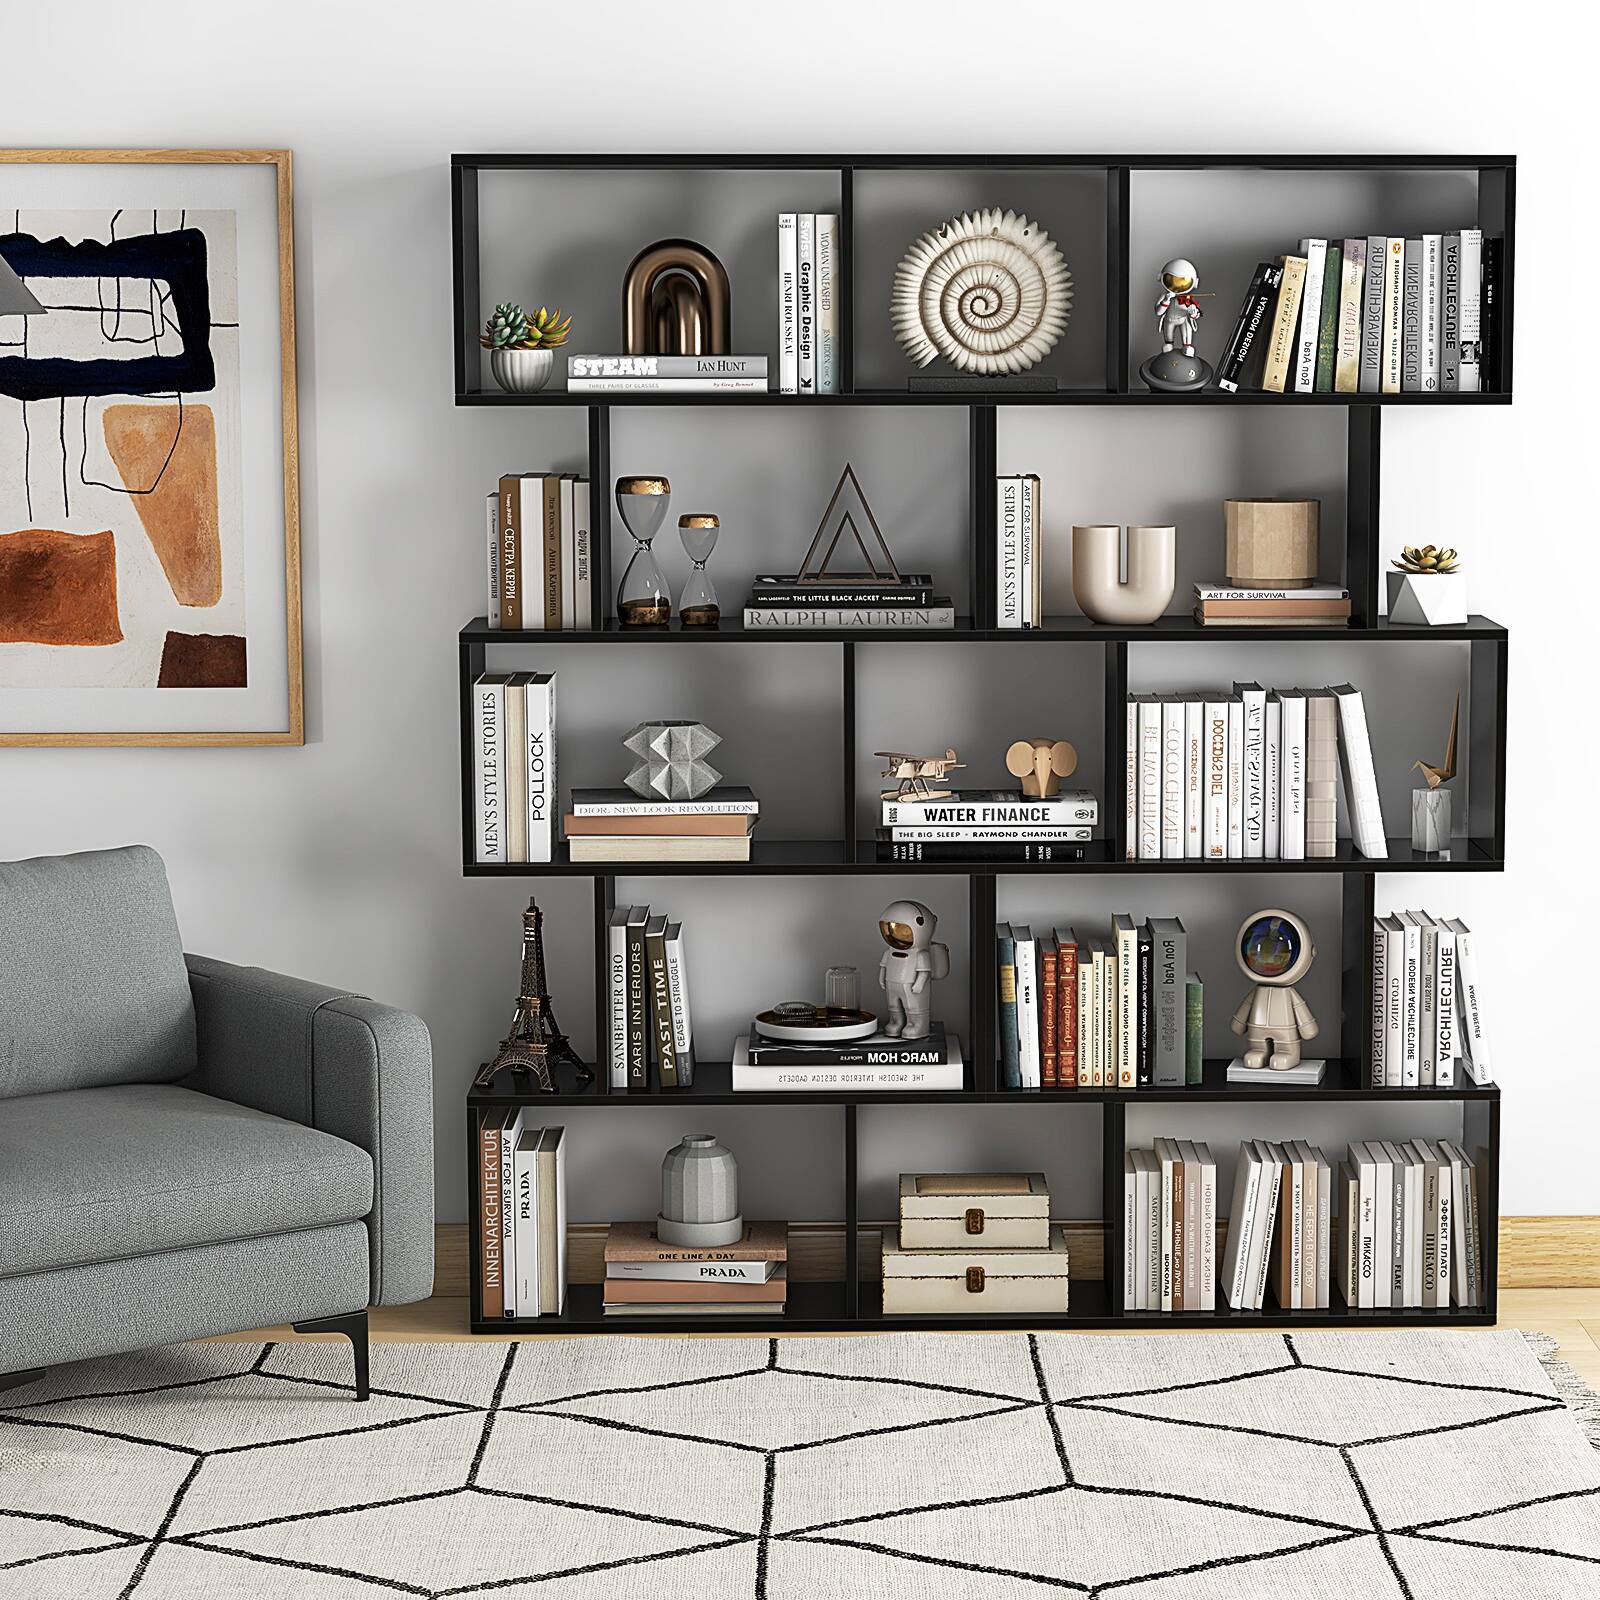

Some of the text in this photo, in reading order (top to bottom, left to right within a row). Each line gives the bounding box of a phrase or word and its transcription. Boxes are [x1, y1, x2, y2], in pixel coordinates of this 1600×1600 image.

[799, 220, 811, 360] Swiss Graphic Design
[820, 232, 831, 311] WOMAN UNLEASHED
[783, 272, 793, 357] HENRI ROUSSEAU
[573, 358, 747, 376] STEAM IAN HUNT
[1004, 485, 1015, 619] MEN'S STYLE STORIES
[1023, 485, 1031, 567] ART FOR SURVIVAL
[504, 527, 516, 599] СЕСТРА КЕРРИ
[577, 529, 588, 581] ФРИДРИХ ЭНГЕЛЬС
[749, 611, 931, 626] RALPH LAUREN
[1207, 591, 1286, 600] ART FOR SURVIVAL
[482, 692, 498, 856] MEN'S STYLE STORIES
[530, 732, 545, 820] POLLOCK
[614, 803, 753, 814] NEW LOOK REVOLUTION
[924, 807, 1050, 821] WATER FINANCE
[669, 958, 681, 1003] STRUGGLE
[612, 954, 625, 1070] SANBETTER OBO
[631, 942, 642, 1077] PARIS INTERIORS
[653, 959, 673, 1070] PAST TIME
[673, 1005, 683, 1016] TO
[675, 1019, 686, 1047] CEASE
[485, 1130, 498, 1288] INNENARCHITEKTUR
[502, 1137, 512, 1240] ART FOR SURVIVAL
[520, 1170, 530, 1220] PRADA
[1305, 1204, 1313, 1217] НЕ
[1204, 1184, 1213, 1293] НОВЫЙ ОБРАЗ ЖИЗНИ
[1305, 1218, 1313, 1242] БЕРИ
[1439, 1198, 1449, 1279] ЭФФЕКТ ПЛАТО
[699, 1267, 747, 1278] PRADA
[1150, 1239, 1158, 1293] ПРЕДАННЫХ
[1304, 1251, 1313, 1288] ГОЛОВУ
[1363, 1236, 1372, 1279] ПИКАССО
[1394, 1264, 1402, 1290] FLAKE
[1425, 1233, 1435, 1291] ПИКАССО
